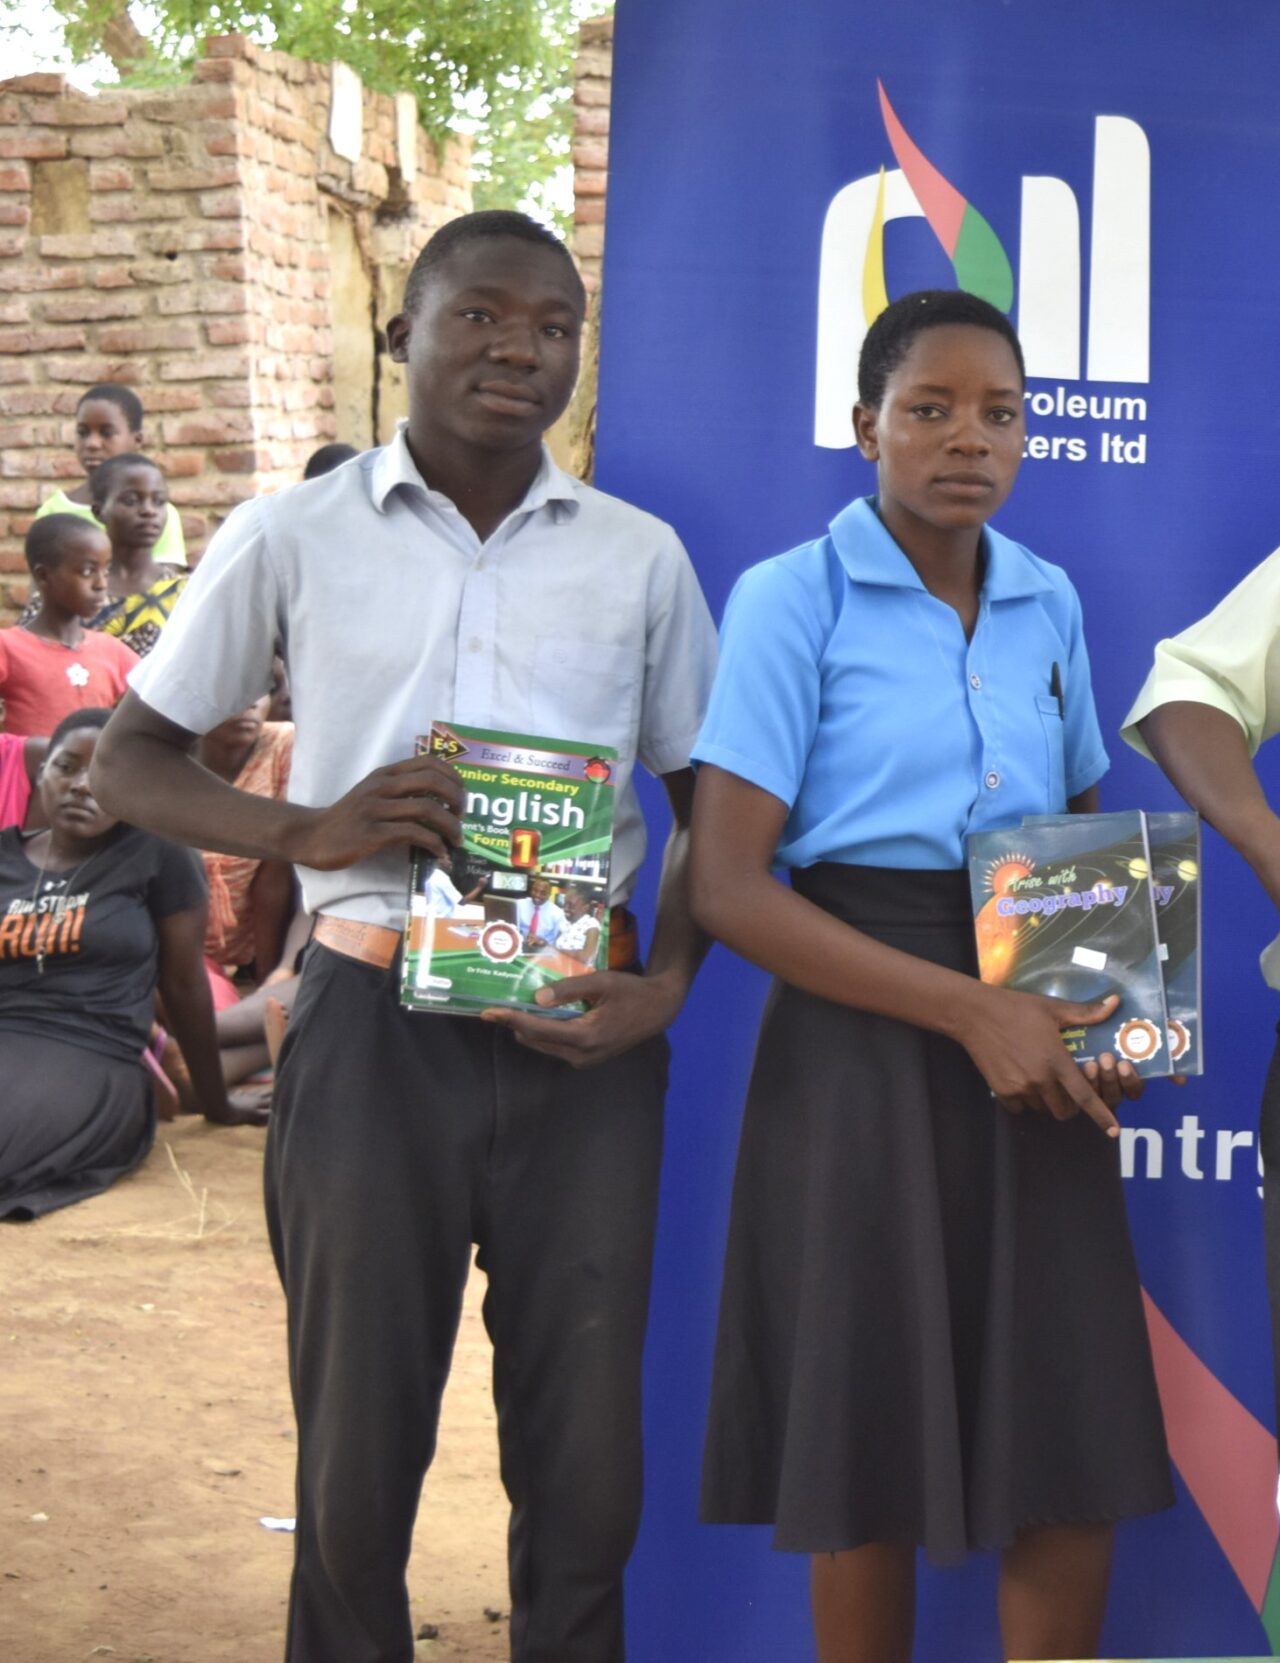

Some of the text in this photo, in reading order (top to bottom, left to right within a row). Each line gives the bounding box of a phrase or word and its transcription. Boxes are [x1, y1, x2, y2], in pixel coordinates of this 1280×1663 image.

[1101, 432, 1147, 464] ltd
[480, 748, 572, 771] Excel & Succeed
[453, 765, 580, 797] unior Secondary
[465, 791, 586, 830] nglish
[461, 820, 510, 836] ent's Book
[472, 833, 510, 848] Form
[515, 833, 533, 864] 1
[1047, 864, 1078, 886] with
[996, 881, 1129, 917] Geography
